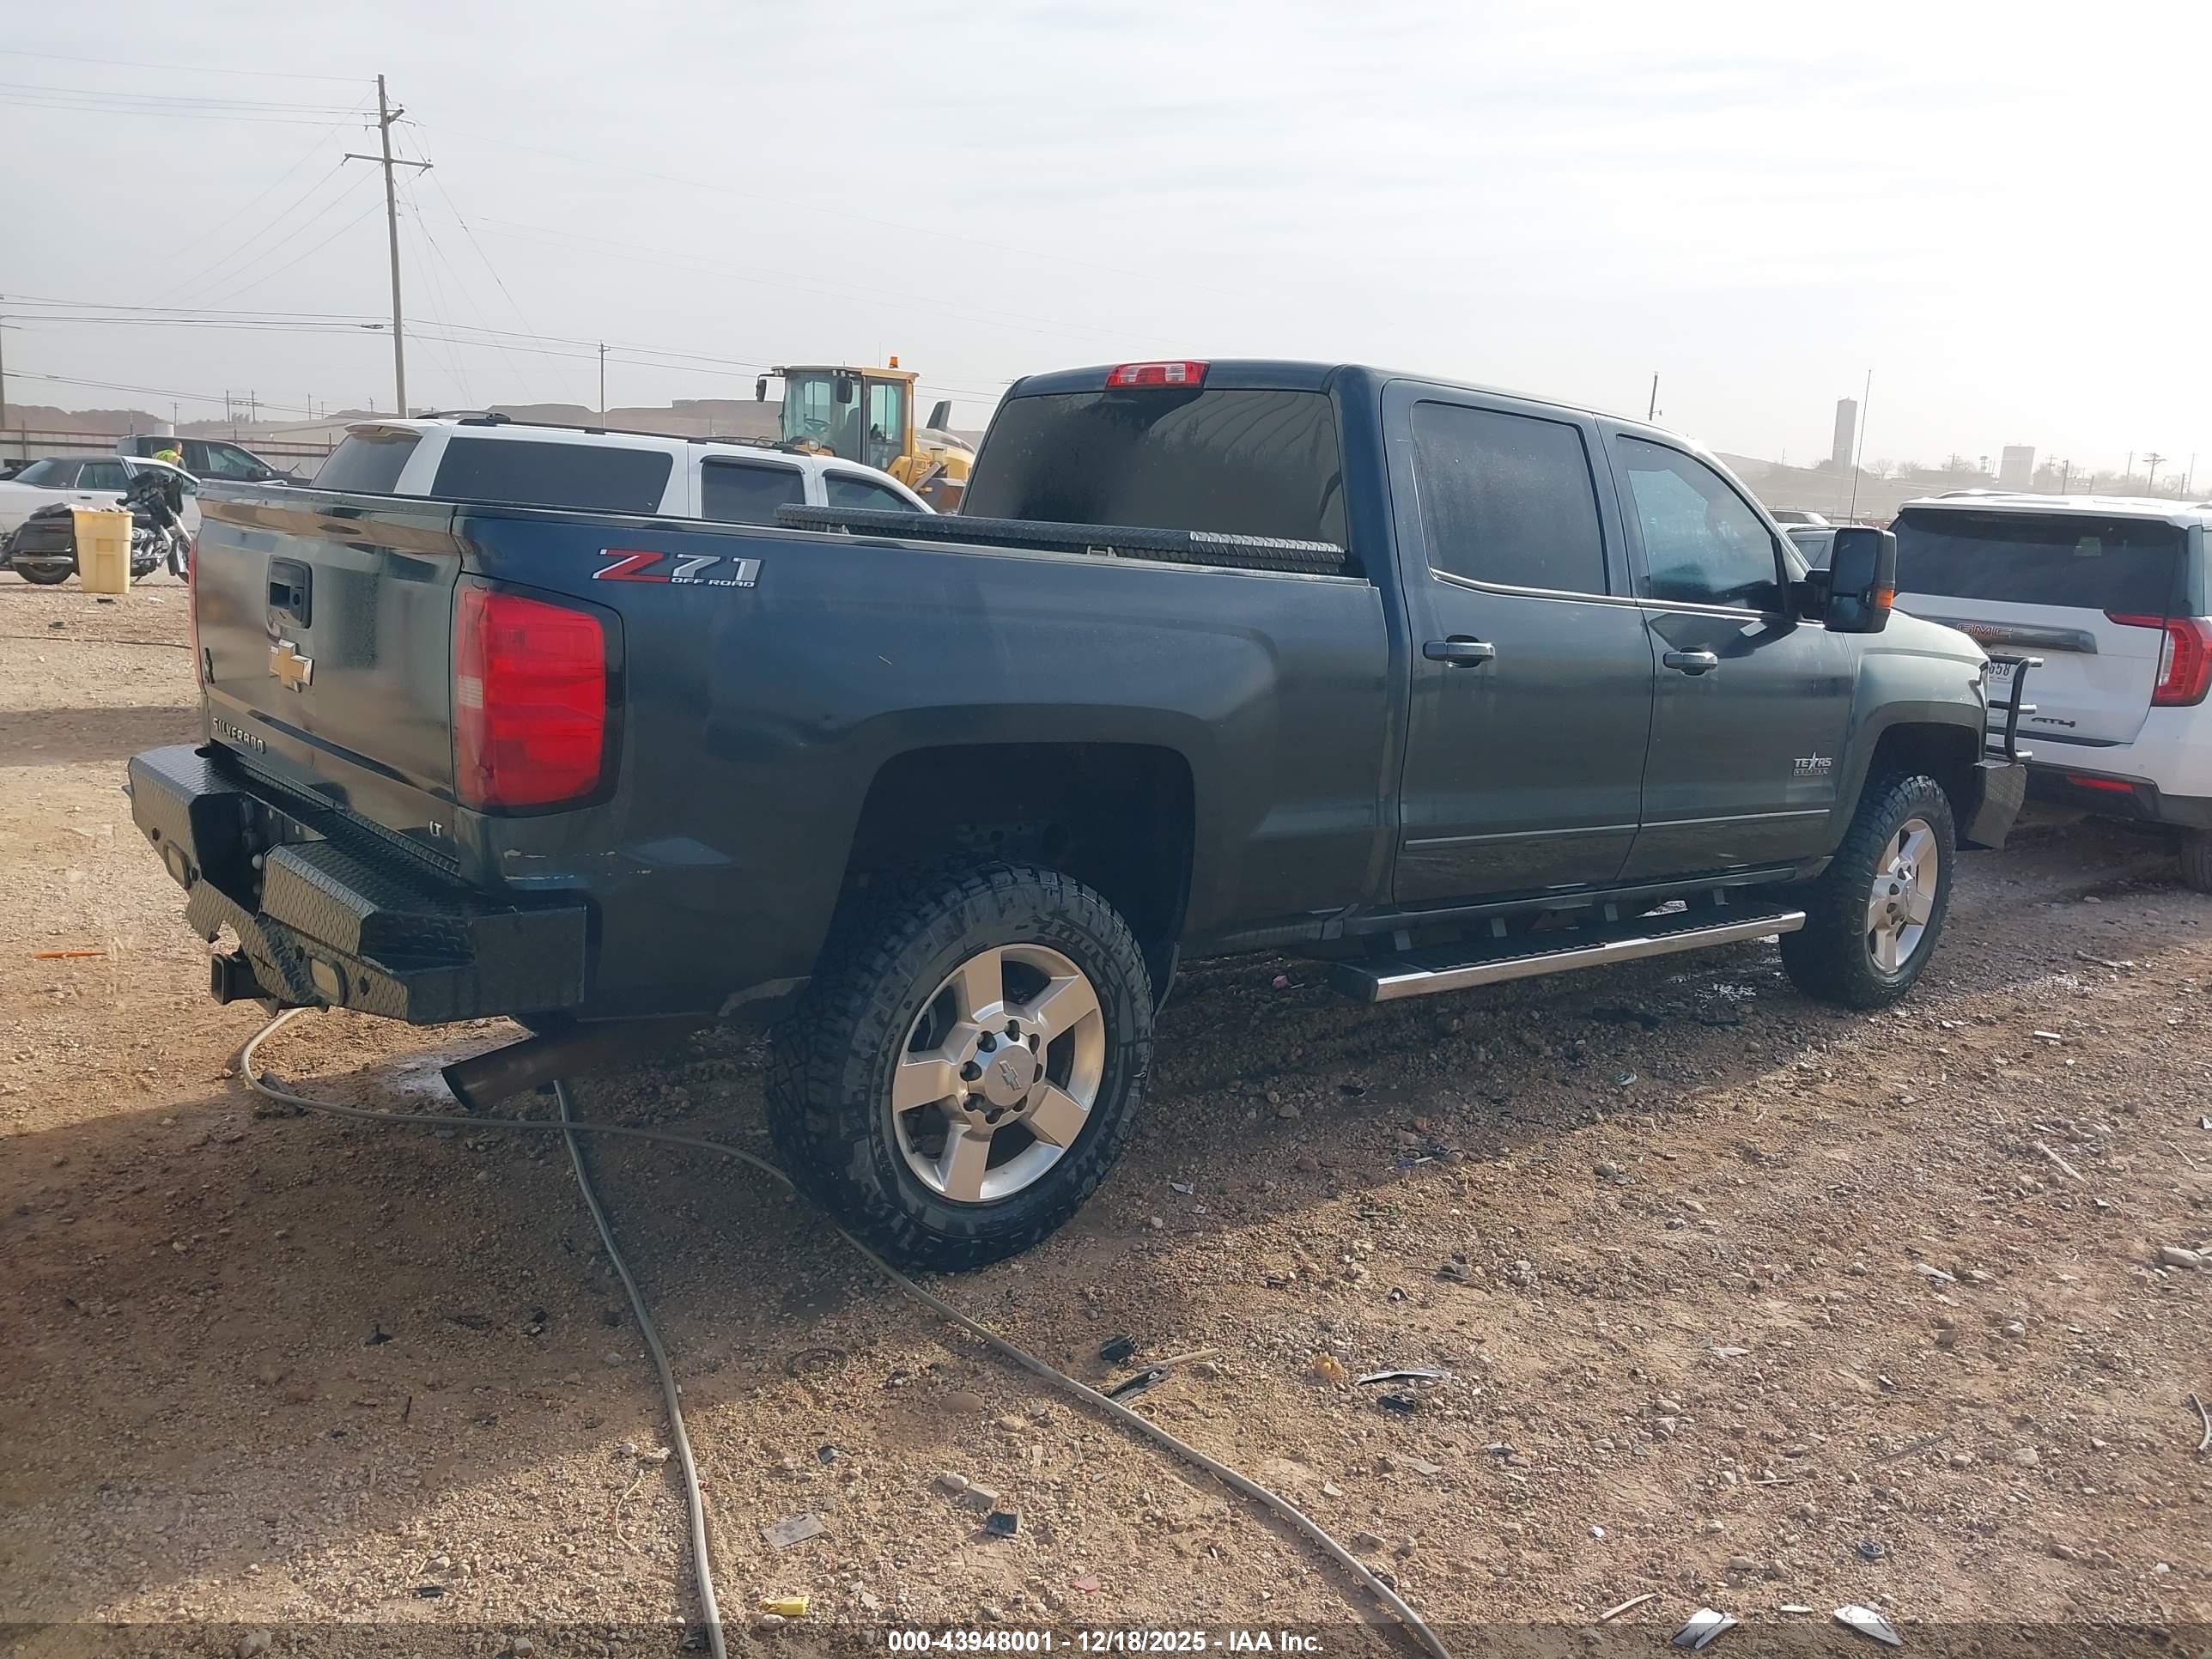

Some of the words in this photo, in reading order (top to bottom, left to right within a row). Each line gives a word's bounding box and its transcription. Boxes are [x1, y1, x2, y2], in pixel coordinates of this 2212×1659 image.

[592, 549, 763, 583] Z71
[708, 579, 756, 588] ROAD
[1957, 623, 2013, 639] GMC
[212, 716, 267, 756] SILVERADO
[1794, 751, 1833, 769] TEXAS
[429, 820, 443, 839] LT
